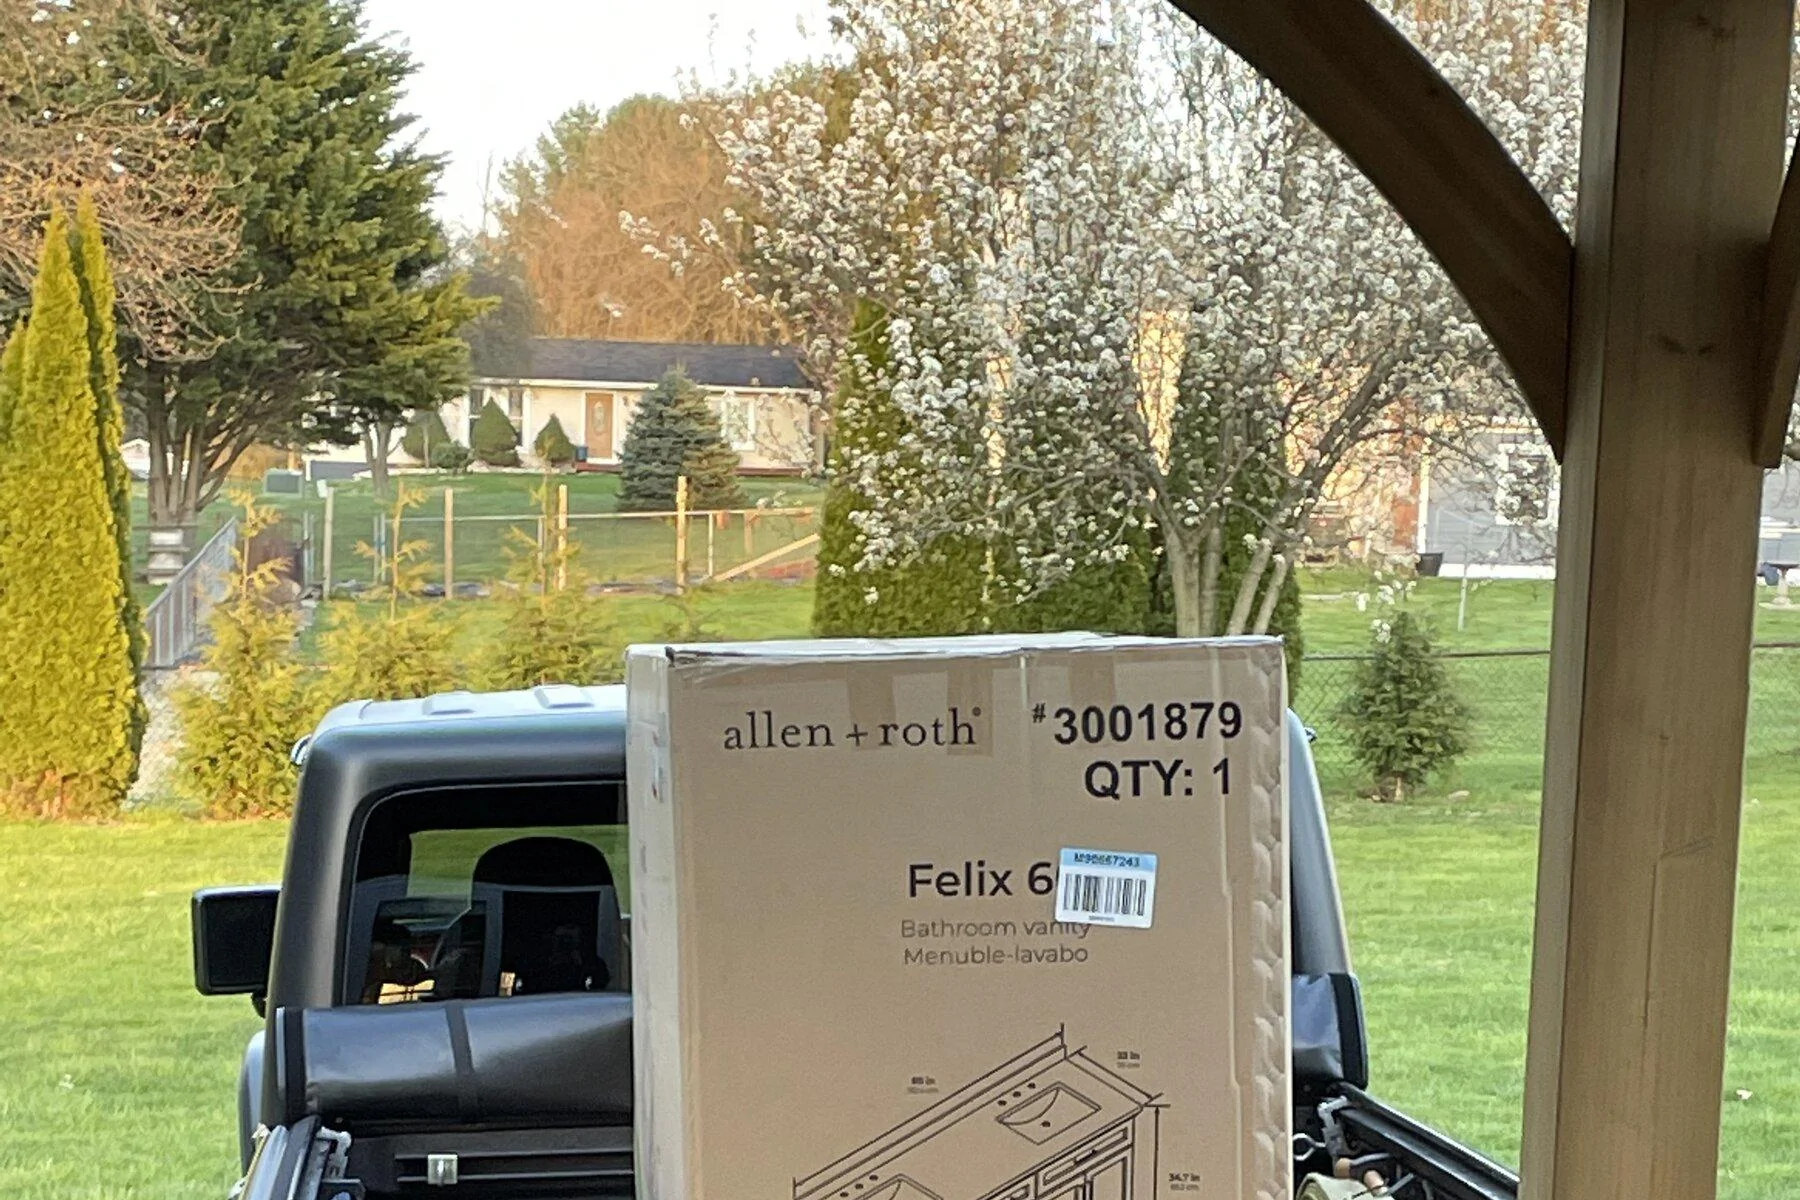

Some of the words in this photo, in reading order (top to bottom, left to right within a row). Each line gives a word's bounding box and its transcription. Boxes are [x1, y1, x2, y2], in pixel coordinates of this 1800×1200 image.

[723, 711, 835, 750] allen
[1031, 701, 1242, 745] #3001879
[1084, 758, 1194, 800] QTY:
[1213, 757, 1230, 795] 1
[908, 860, 1013, 898] Felix
[901, 918, 1017, 939] Bathroom
[1022, 920, 1092, 940] vanity
[903, 943, 1089, 966] Menuble-lavabo
